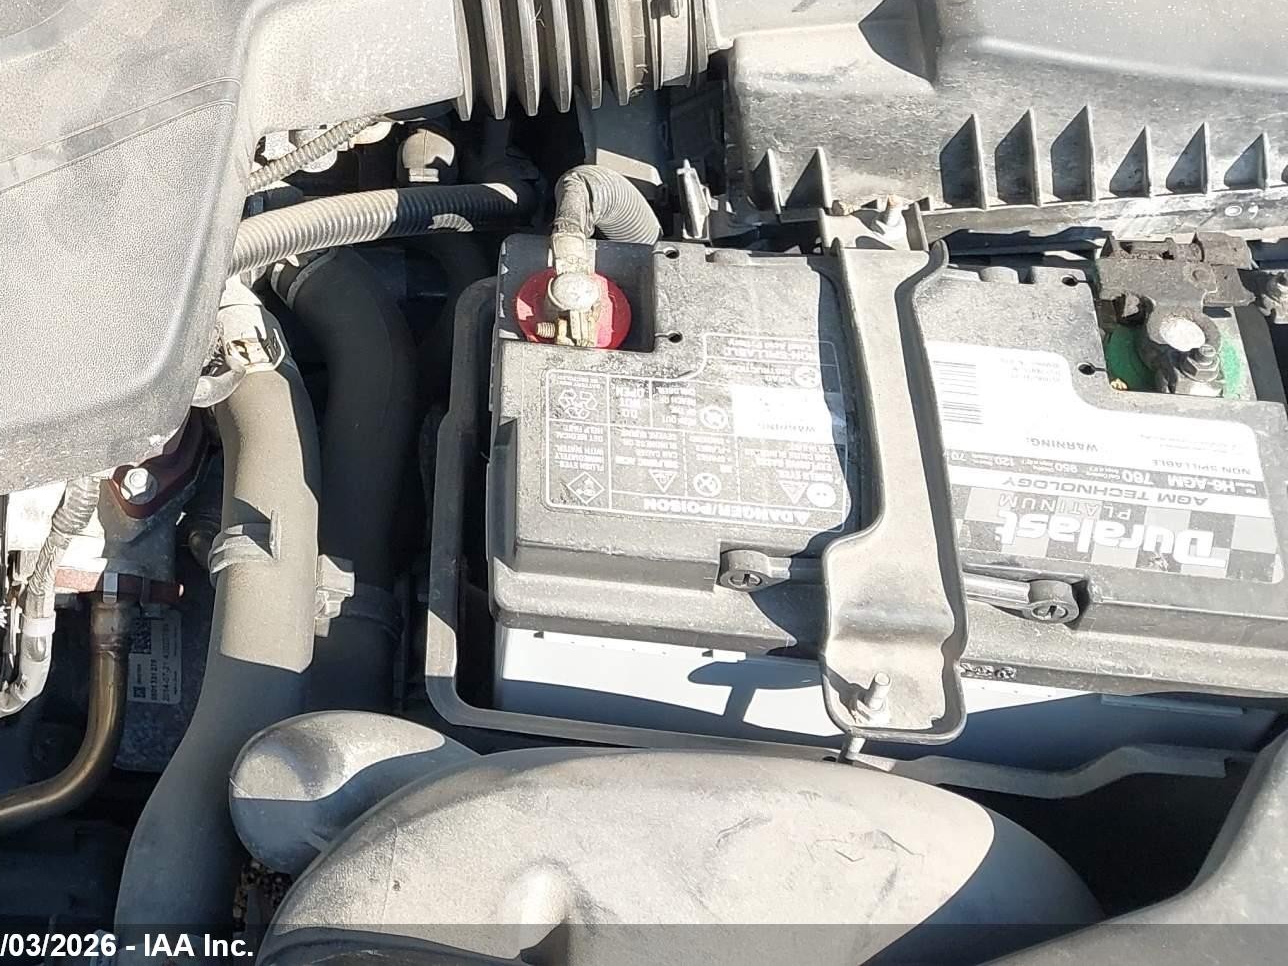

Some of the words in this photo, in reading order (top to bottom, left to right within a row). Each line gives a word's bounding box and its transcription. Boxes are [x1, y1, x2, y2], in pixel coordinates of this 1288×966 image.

[1025, 437, 1099, 453] WARNING:
[995, 456, 1015, 467] 120
[1053, 462, 1078, 473] 950
[1151, 459, 1217, 472] SPILLABLE
[1222, 466, 1251, 476] NON
[1001, 476, 1150, 502] TECHNOLOGY
[998, 492, 1132, 521] PLATINUM
[1156, 492, 1209, 507] AGM
[995, 509, 1228, 569] Duralast
